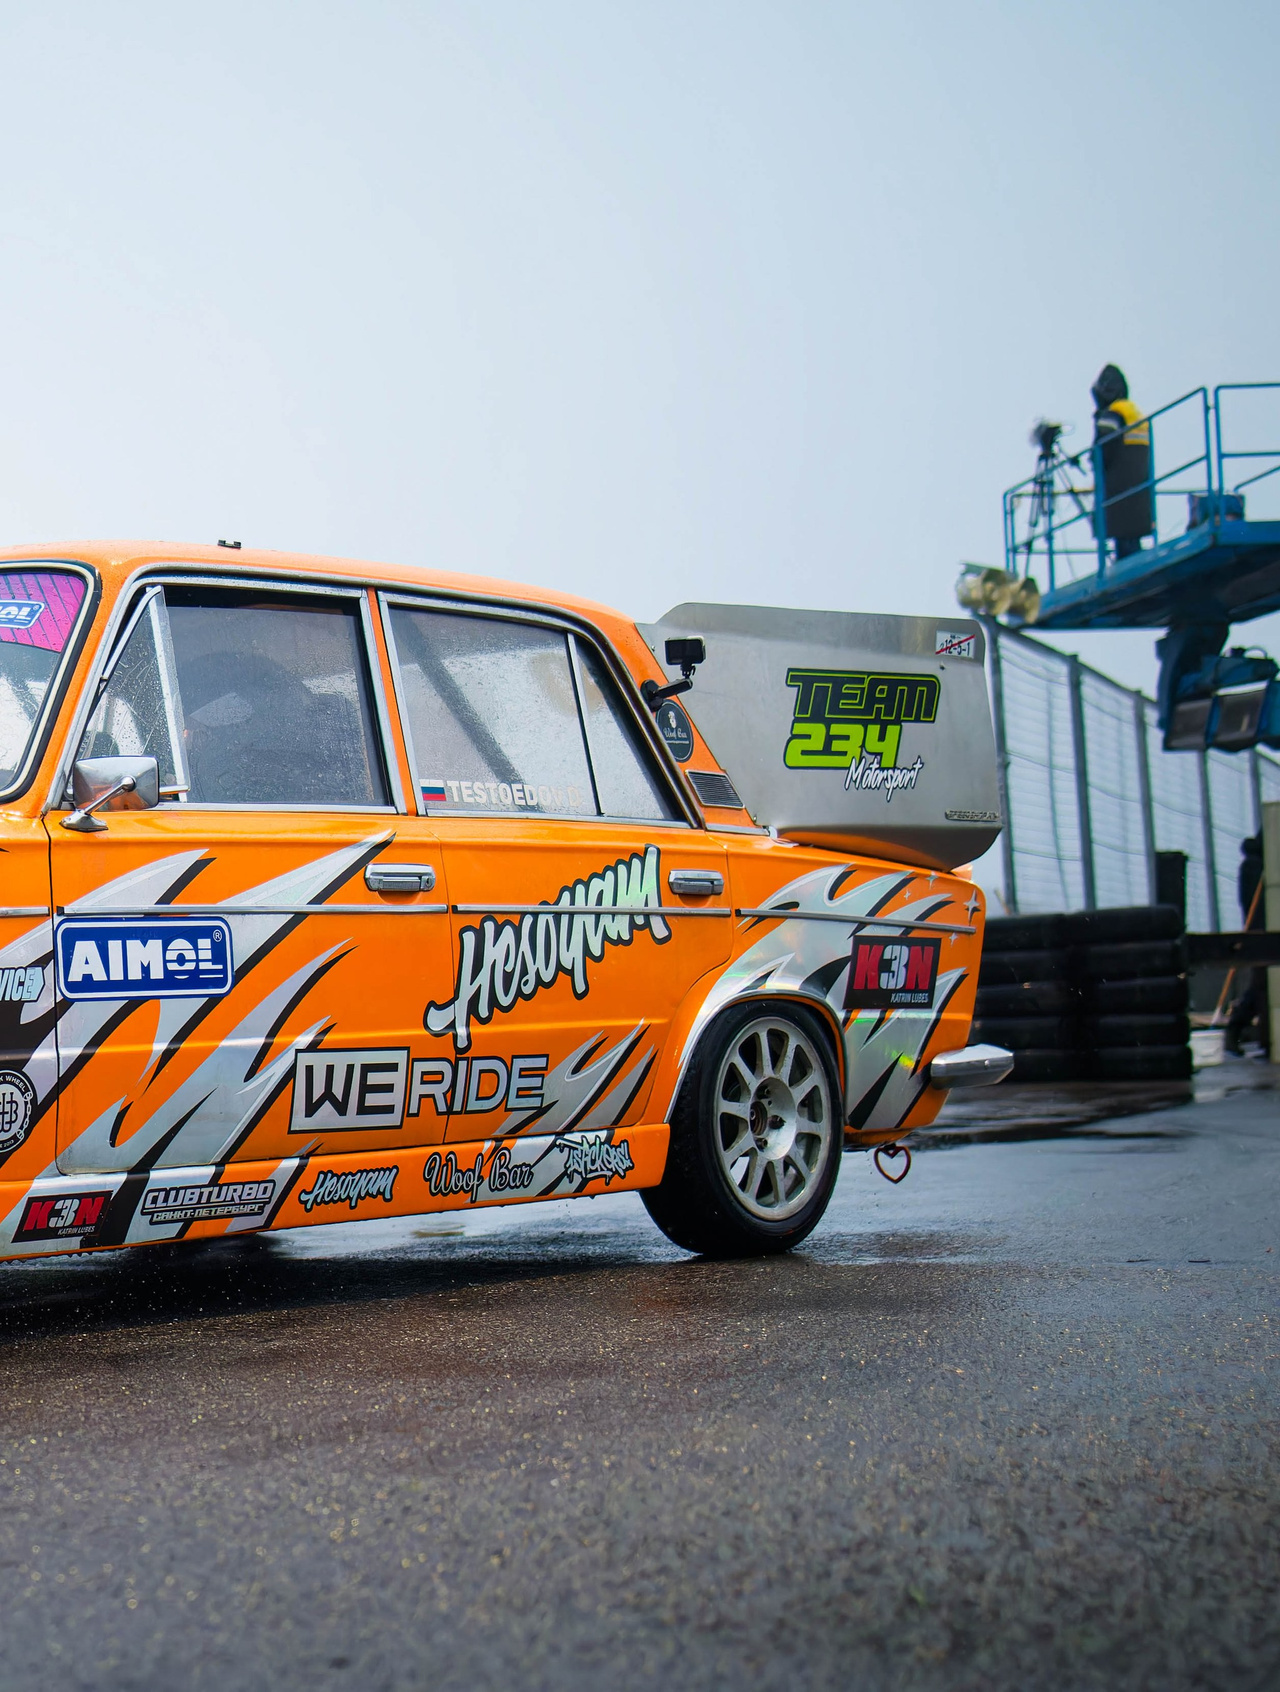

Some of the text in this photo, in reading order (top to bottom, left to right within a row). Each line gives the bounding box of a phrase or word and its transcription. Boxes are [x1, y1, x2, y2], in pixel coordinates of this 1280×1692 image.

[786, 668, 941, 723] TEAM
[784, 721, 902, 769] 234
[844, 755, 924, 802] Motorsport
[852, 944, 935, 990] K3N
[890, 992, 929, 1003] KATRIN LUBES
[5, 1075, 26, 1092] WHEEL
[144, 1182, 275, 1209] CLUBTURBO
[423, 1148, 534, 1203] Woof Bar
[22, 1196, 105, 1232] K3N
[78, 1225, 96, 1234] LUBES
